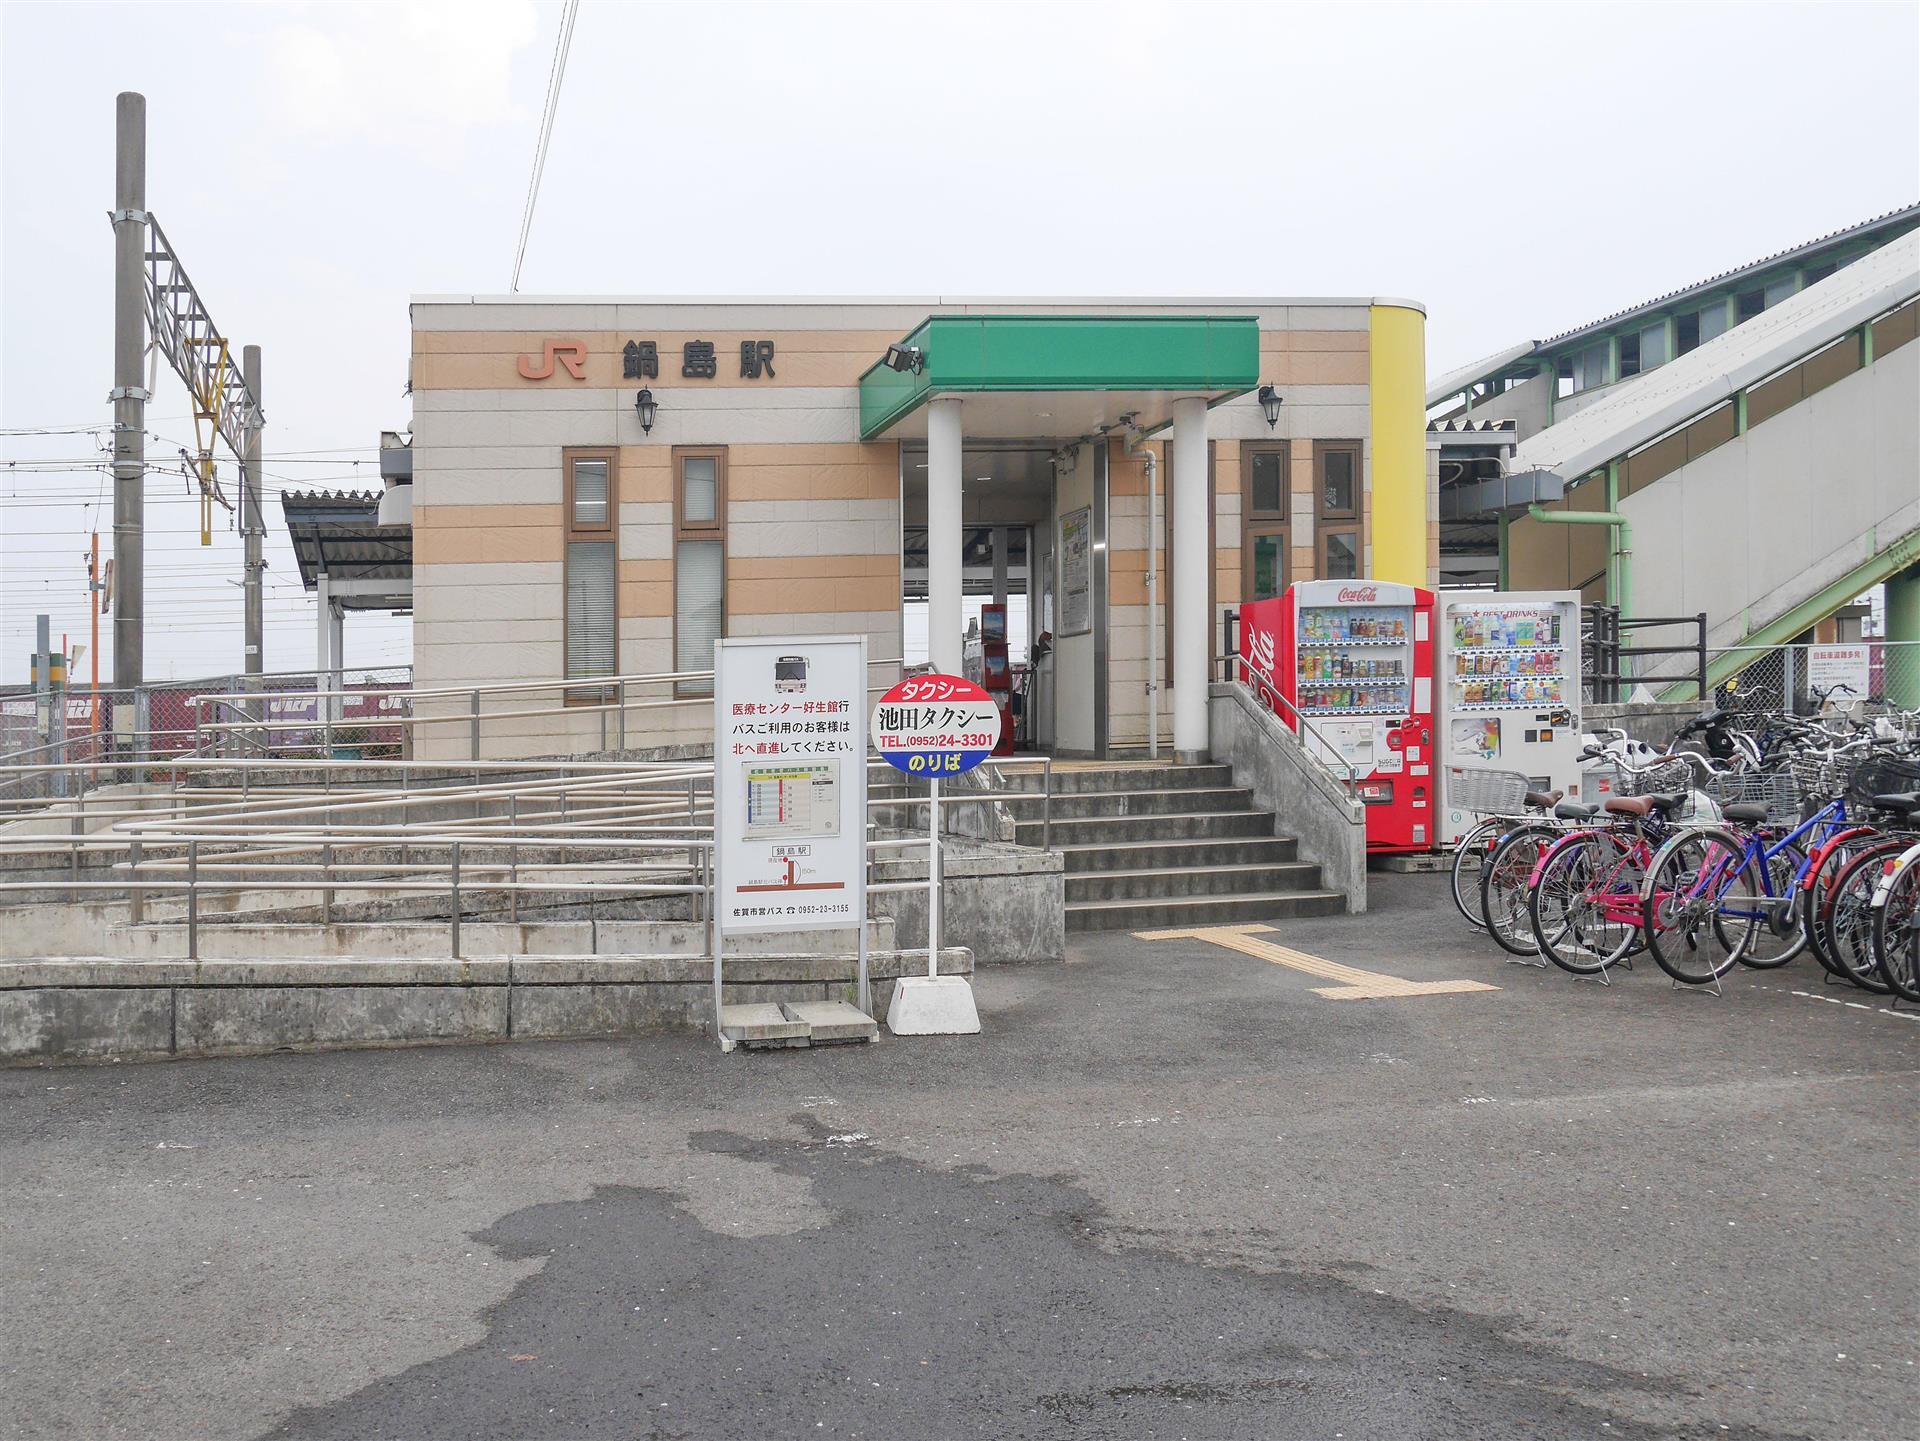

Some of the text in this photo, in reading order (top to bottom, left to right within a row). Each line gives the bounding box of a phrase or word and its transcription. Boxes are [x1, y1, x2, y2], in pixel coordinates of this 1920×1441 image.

[516, 338, 776, 380] JR 鍋島駅
[1338, 586, 1377, 602] Coca-Cola
[1506, 610, 1538, 618] DRINKS
[901, 681, 972, 701] タクシー
[732, 700, 850, 715] 医療センター好生館行
[878, 706, 994, 731] 池田タクシー
[732, 721, 850, 735] バスご利用のお客様は
[732, 741, 855, 755] 北へ直進してください。
[908, 753, 962, 772] のりば
[776, 846, 807, 856] 鍋島駅
[733, 904, 849, 917] 佐賀市営バス 0952-23-3155
